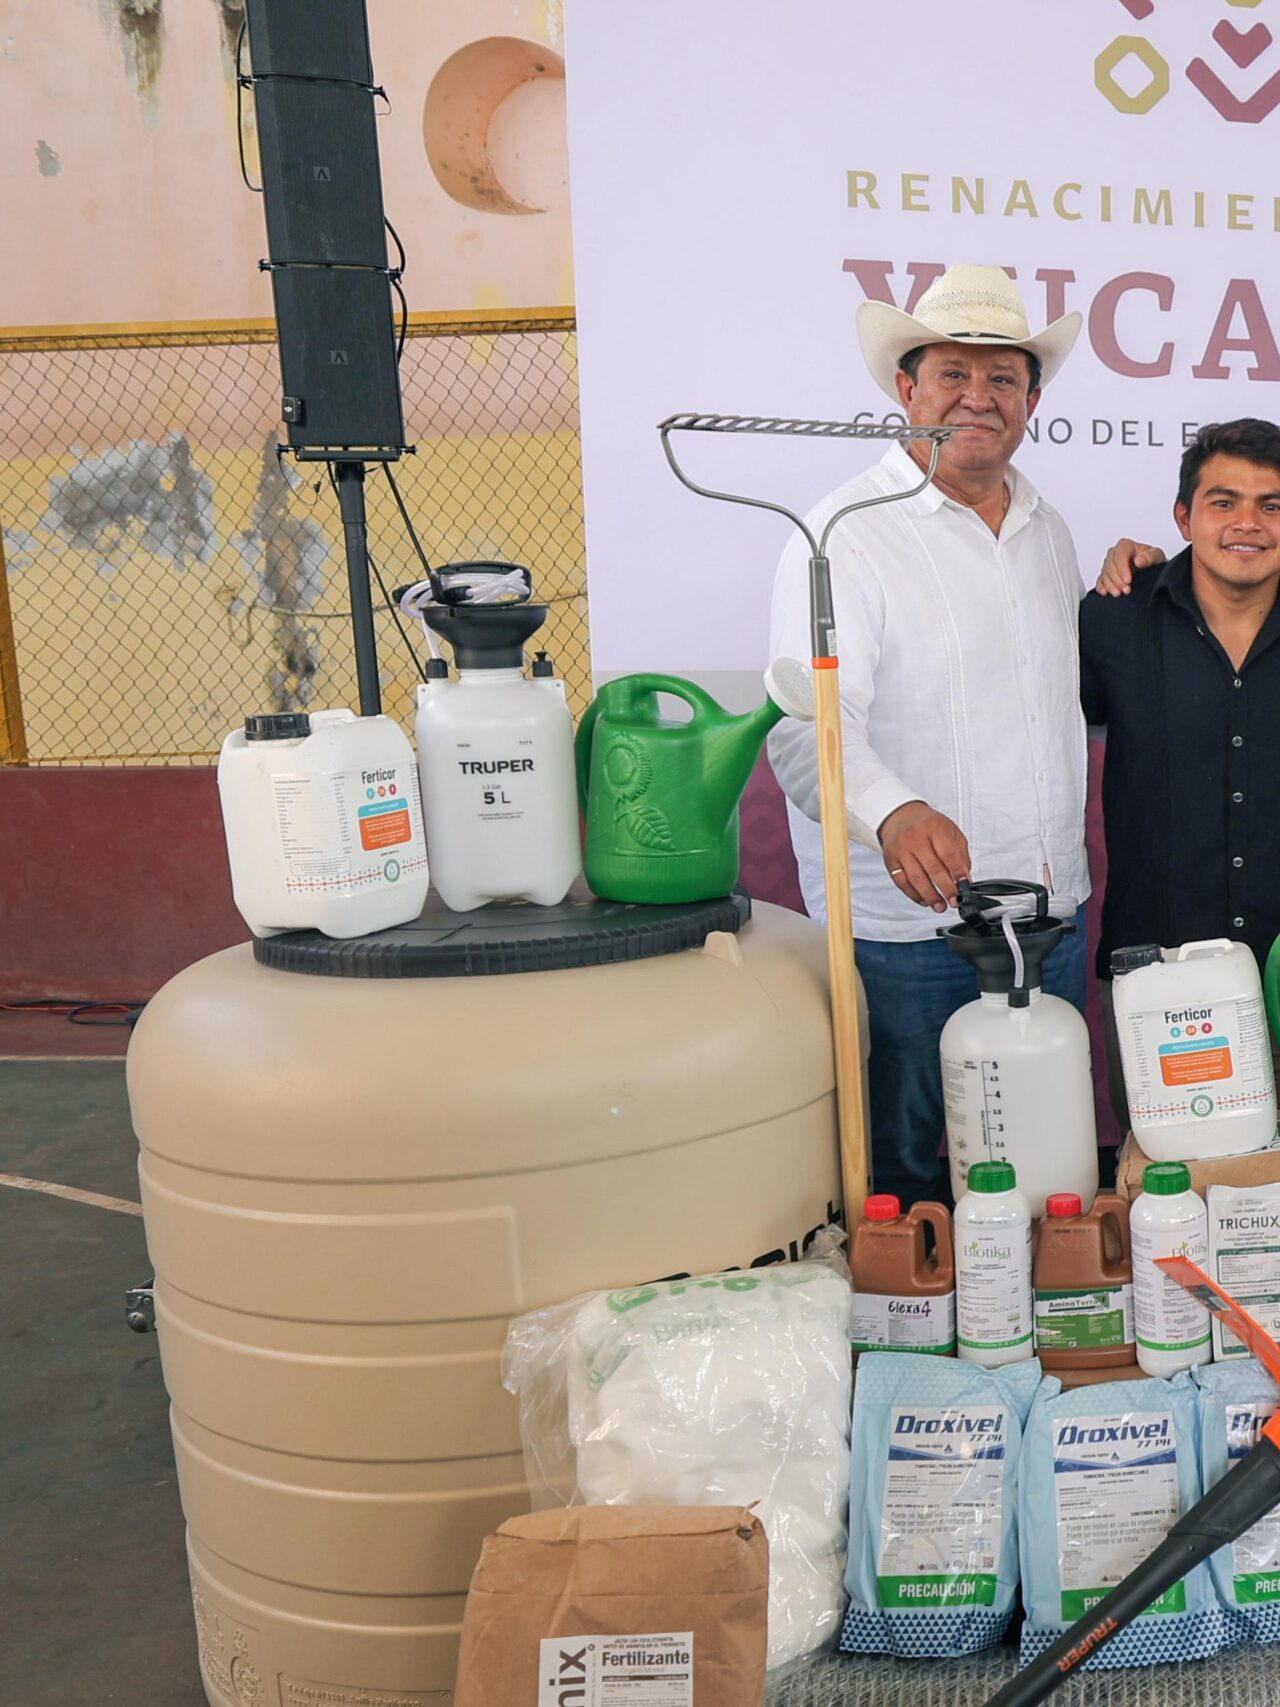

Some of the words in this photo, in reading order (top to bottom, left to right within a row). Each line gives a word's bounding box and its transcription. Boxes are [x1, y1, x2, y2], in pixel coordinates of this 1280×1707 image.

[1091, 419, 1164, 447] DEL
[458, 758, 535, 774] TRUPER
[361, 768, 396, 784] Ferticor
[484, 792, 495, 804] 5
[501, 791, 511, 804] L
[1164, 1008, 1213, 1024] Ferticor
[963, 1242, 1012, 1259] Biotika
[895, 1414, 1003, 1434] Droxivel
[1058, 1419, 1168, 1446] Droxivel
[899, 1579, 976, 1598] PRECAUCIÓN
[1056, 1616, 1119, 1672] TRUPER
[602, 1650, 690, 1666] Fertilizante
